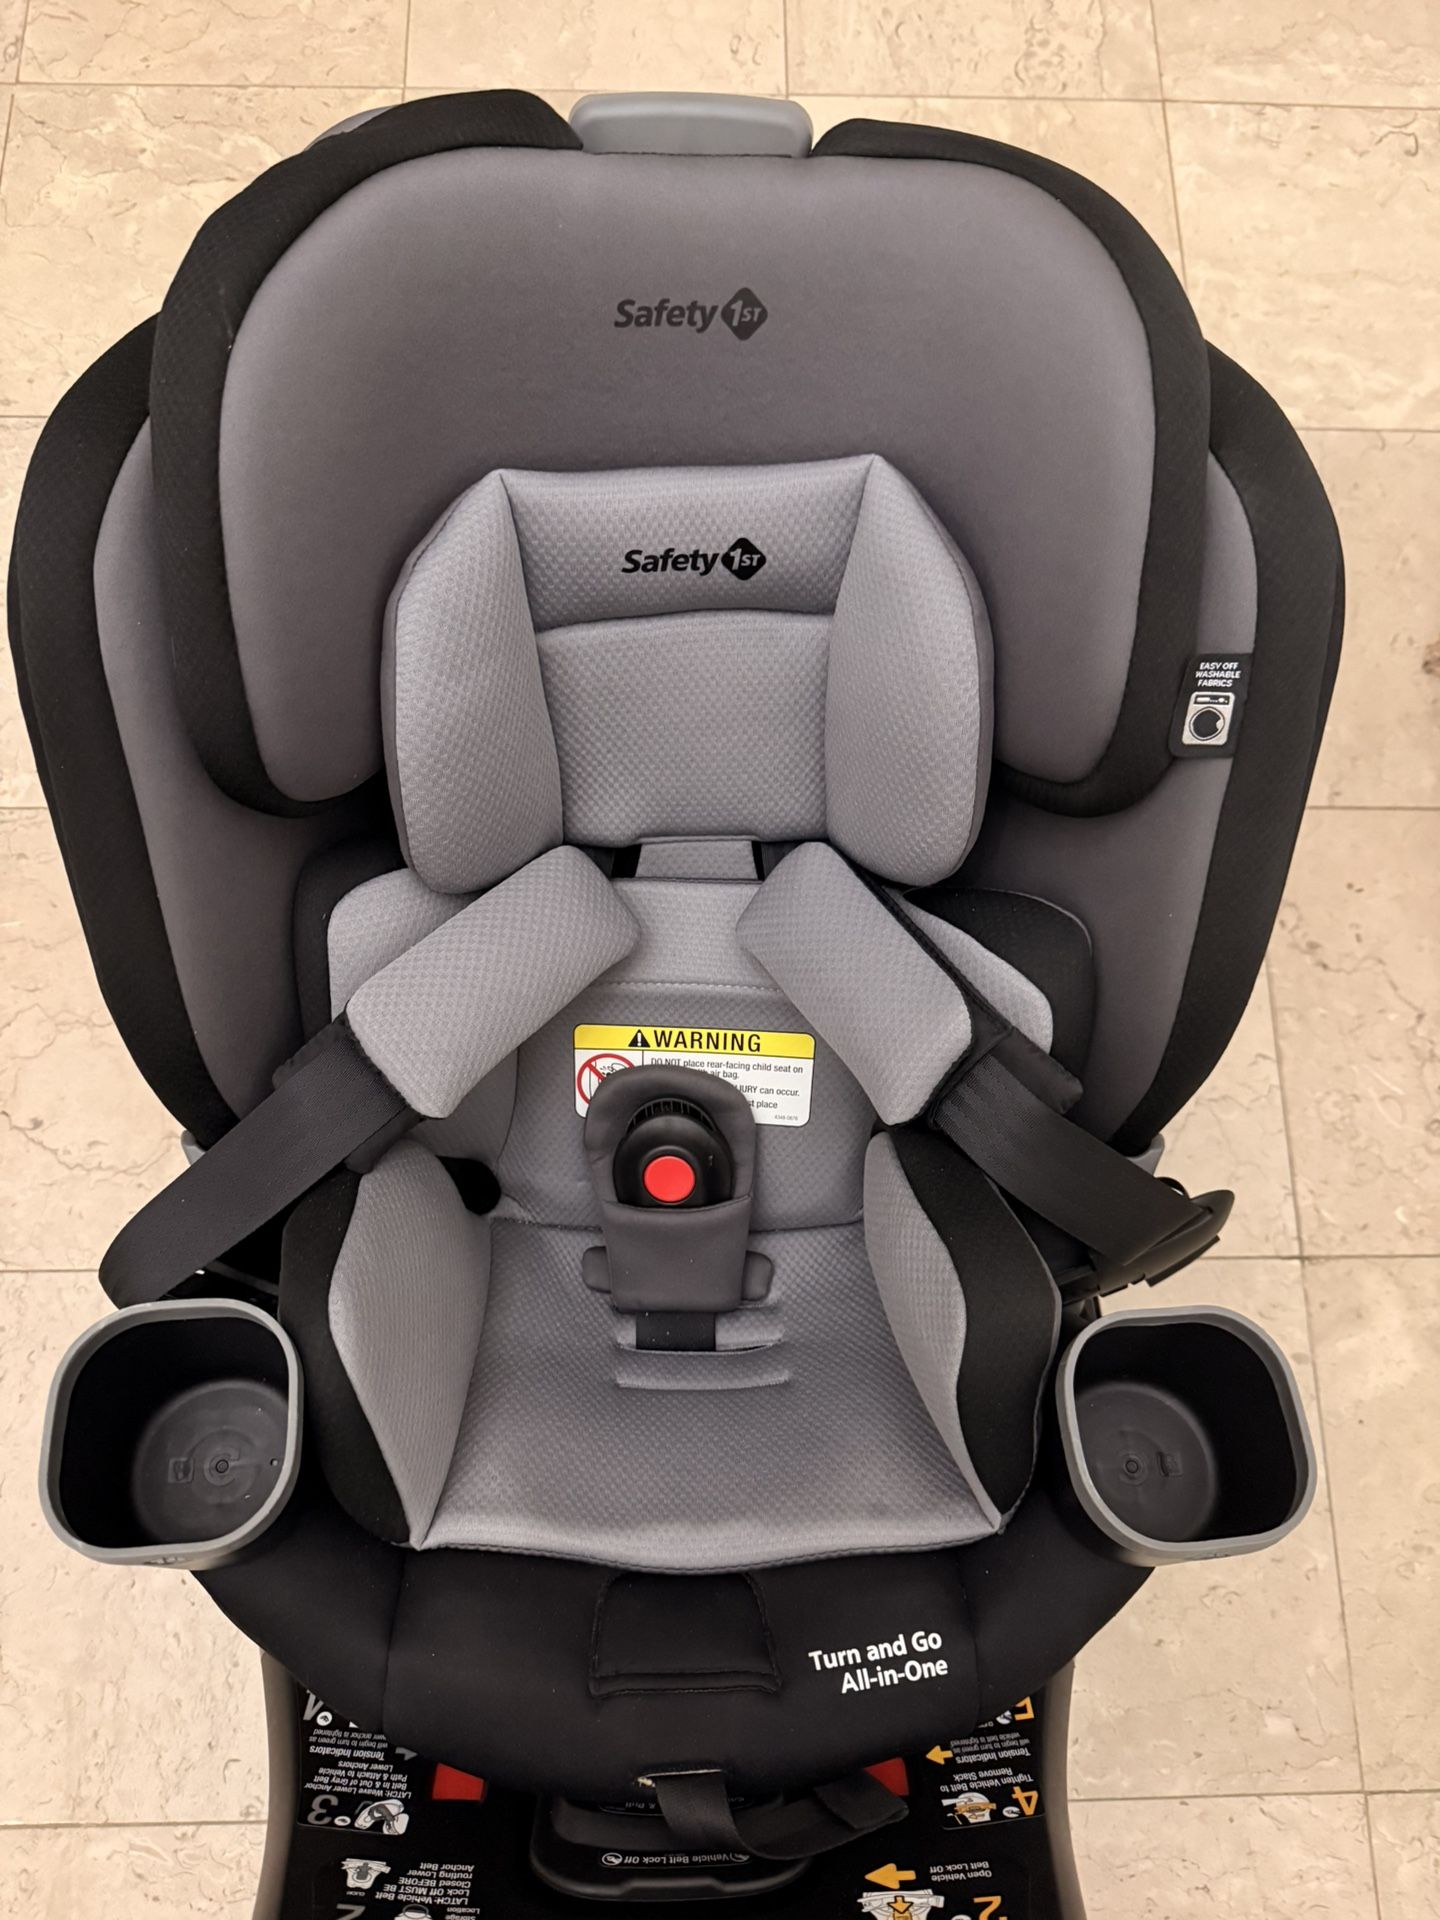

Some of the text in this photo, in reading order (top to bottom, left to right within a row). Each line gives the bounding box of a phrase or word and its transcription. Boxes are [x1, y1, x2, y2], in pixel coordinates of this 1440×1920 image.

[614, 299, 718, 333] Safety
[622, 548, 718, 575] Safety
[1198, 679, 1233, 687] FABRICS
[654, 1030, 761, 1052] WARNING
[683, 1060, 704, 1069] place
[707, 1060, 750, 1071] rear-facing
[752, 1062, 771, 1072] child
[774, 1063, 791, 1072] seat
[793, 1065, 803, 1073] on
[722, 1070, 739, 1079] bag.
[733, 1085, 800, 1096] JURY can occur.
[756, 1100, 778, 1109] place
[808, 1631, 943, 1671] Turn and Go
[841, 1659, 949, 1694] All-in-One
[309, 1746, 385, 1761] Tension Indicators
[955, 1747, 1031, 1764] Tension Indicators
[318, 1767, 345, 1776] Vehicle
[338, 1761, 393, 1772] Lower Anchors
[313, 1775, 330, 1783] Belt
[357, 1771, 381, 1779] Attach
[953, 1767, 1013, 1782] Remove Slack
[1001, 1773, 1033, 1785] Tighten
[331, 1776, 348, 1785] Grey
[969, 1778, 1000, 1790] Vehicle
[304, 1783, 412, 1799] LATCH: Weave Lower Anchor
[950, 1783, 968, 1792] Belt
[1011, 1785, 1039, 1816] 4
[307, 1794, 339, 1824] 3
[623, 1856, 639, 1864] Off
[643, 1856, 666, 1865] Lock
[669, 1856, 689, 1864] Belt
[692, 1852, 729, 1864] Vehicle
[419, 1862, 475, 1872] Anchor Belt
[929, 1861, 989, 1873] Belt Lock Off
[406, 1870, 473, 1879] routing Lower
[931, 1869, 992, 1881] Open Vehicle
[397, 1877, 471, 1888] Closed BEFORE
[399, 1886, 427, 1895] MUST
[429, 1888, 444, 1896] Off
[375, 1892, 468, 1905] LATCH: Vehicle Belt
